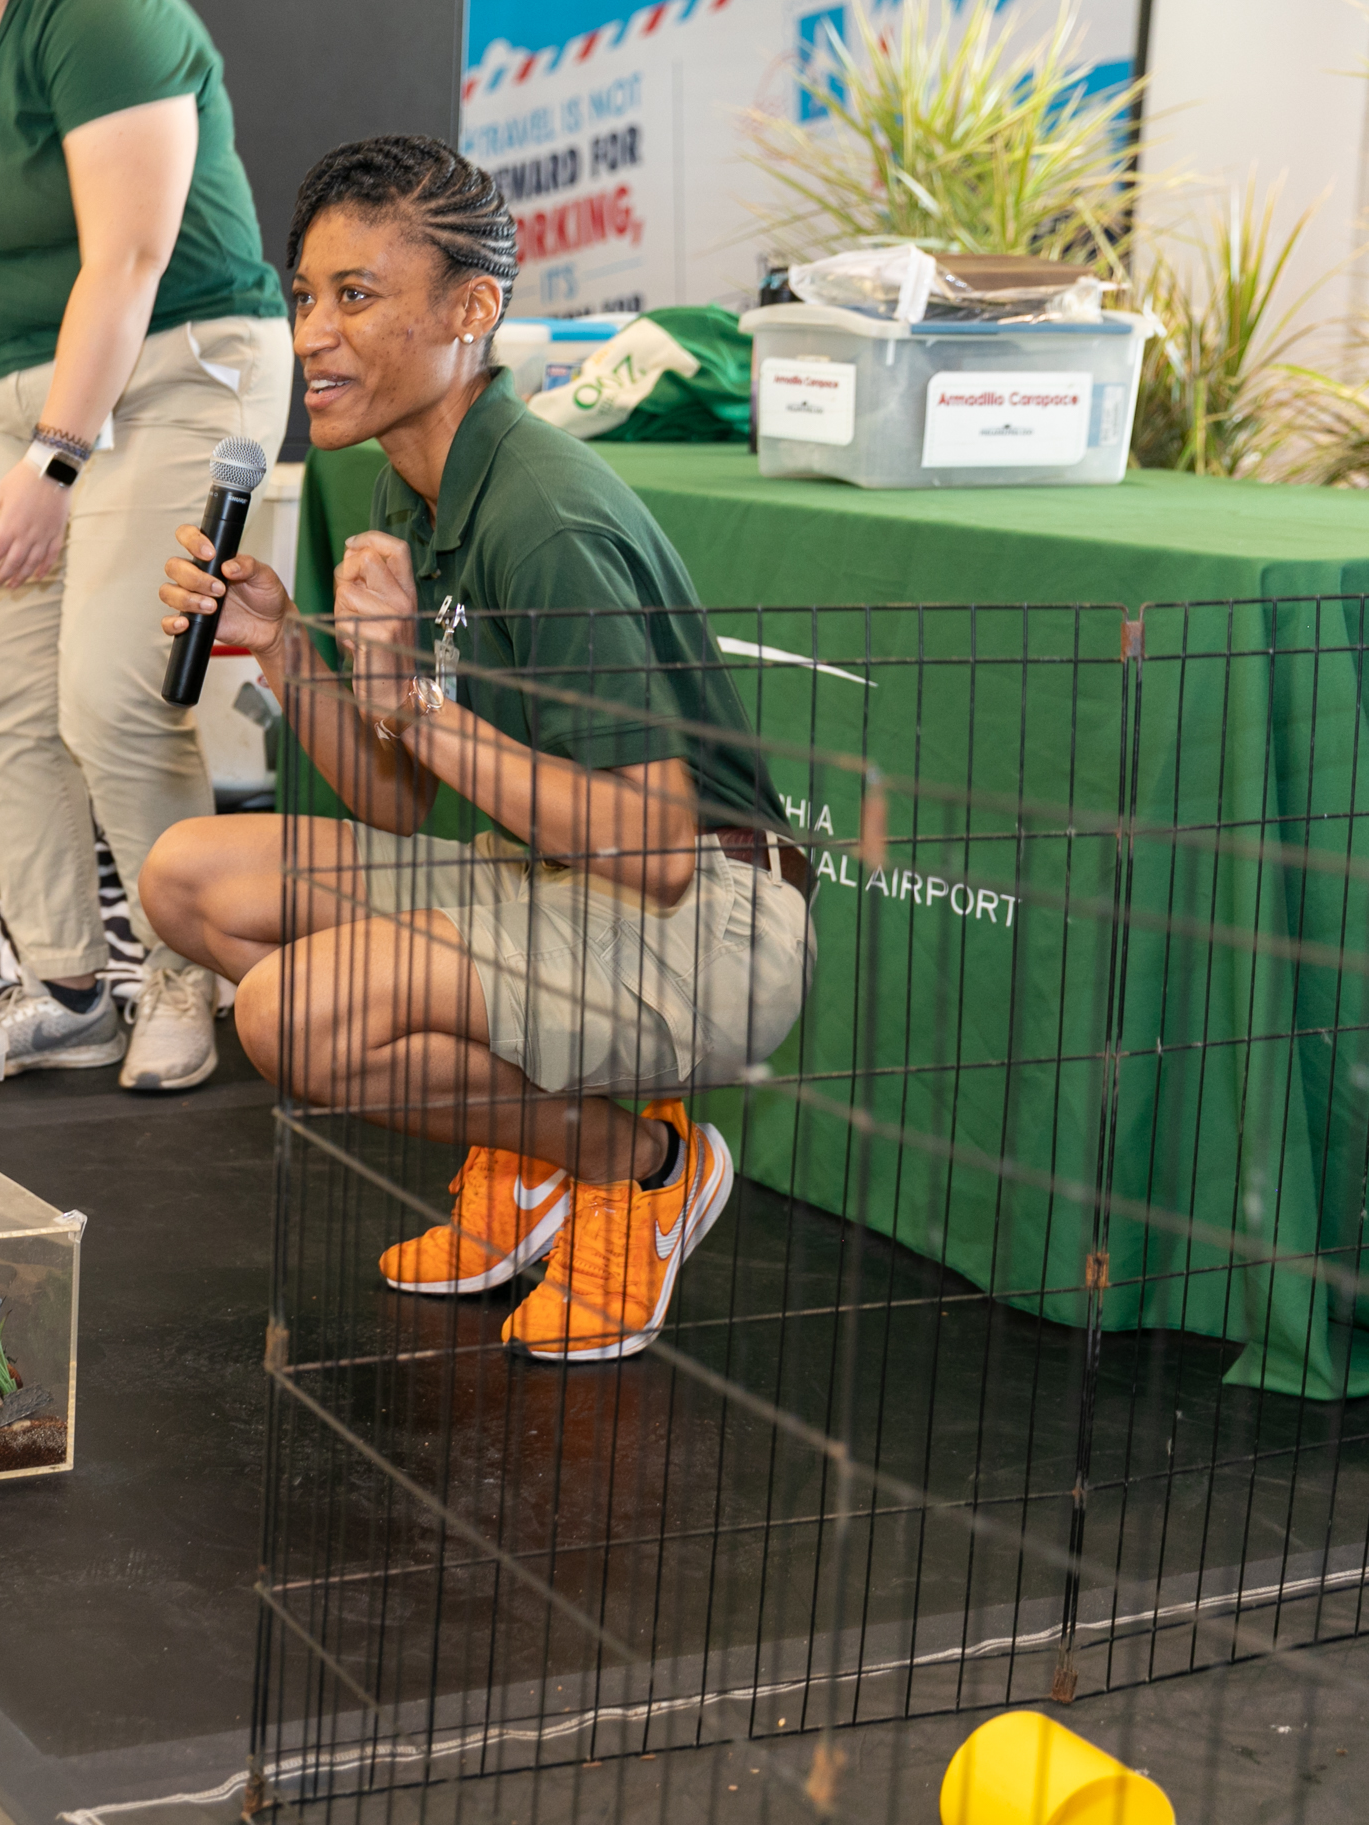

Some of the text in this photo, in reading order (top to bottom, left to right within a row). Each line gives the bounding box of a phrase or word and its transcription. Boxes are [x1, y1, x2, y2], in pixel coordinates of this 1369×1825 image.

[481, 72, 642, 156] TRAVEL IS NOT
[492, 125, 639, 199] EWARD FOR
[515, 187, 644, 264] ORKING,
[540, 262, 577, 304] IT'S
[937, 391, 1079, 409] Armadillo Carapace
[780, 793, 834, 836] HIA
[812, 847, 1020, 928] AL AIRPORT
